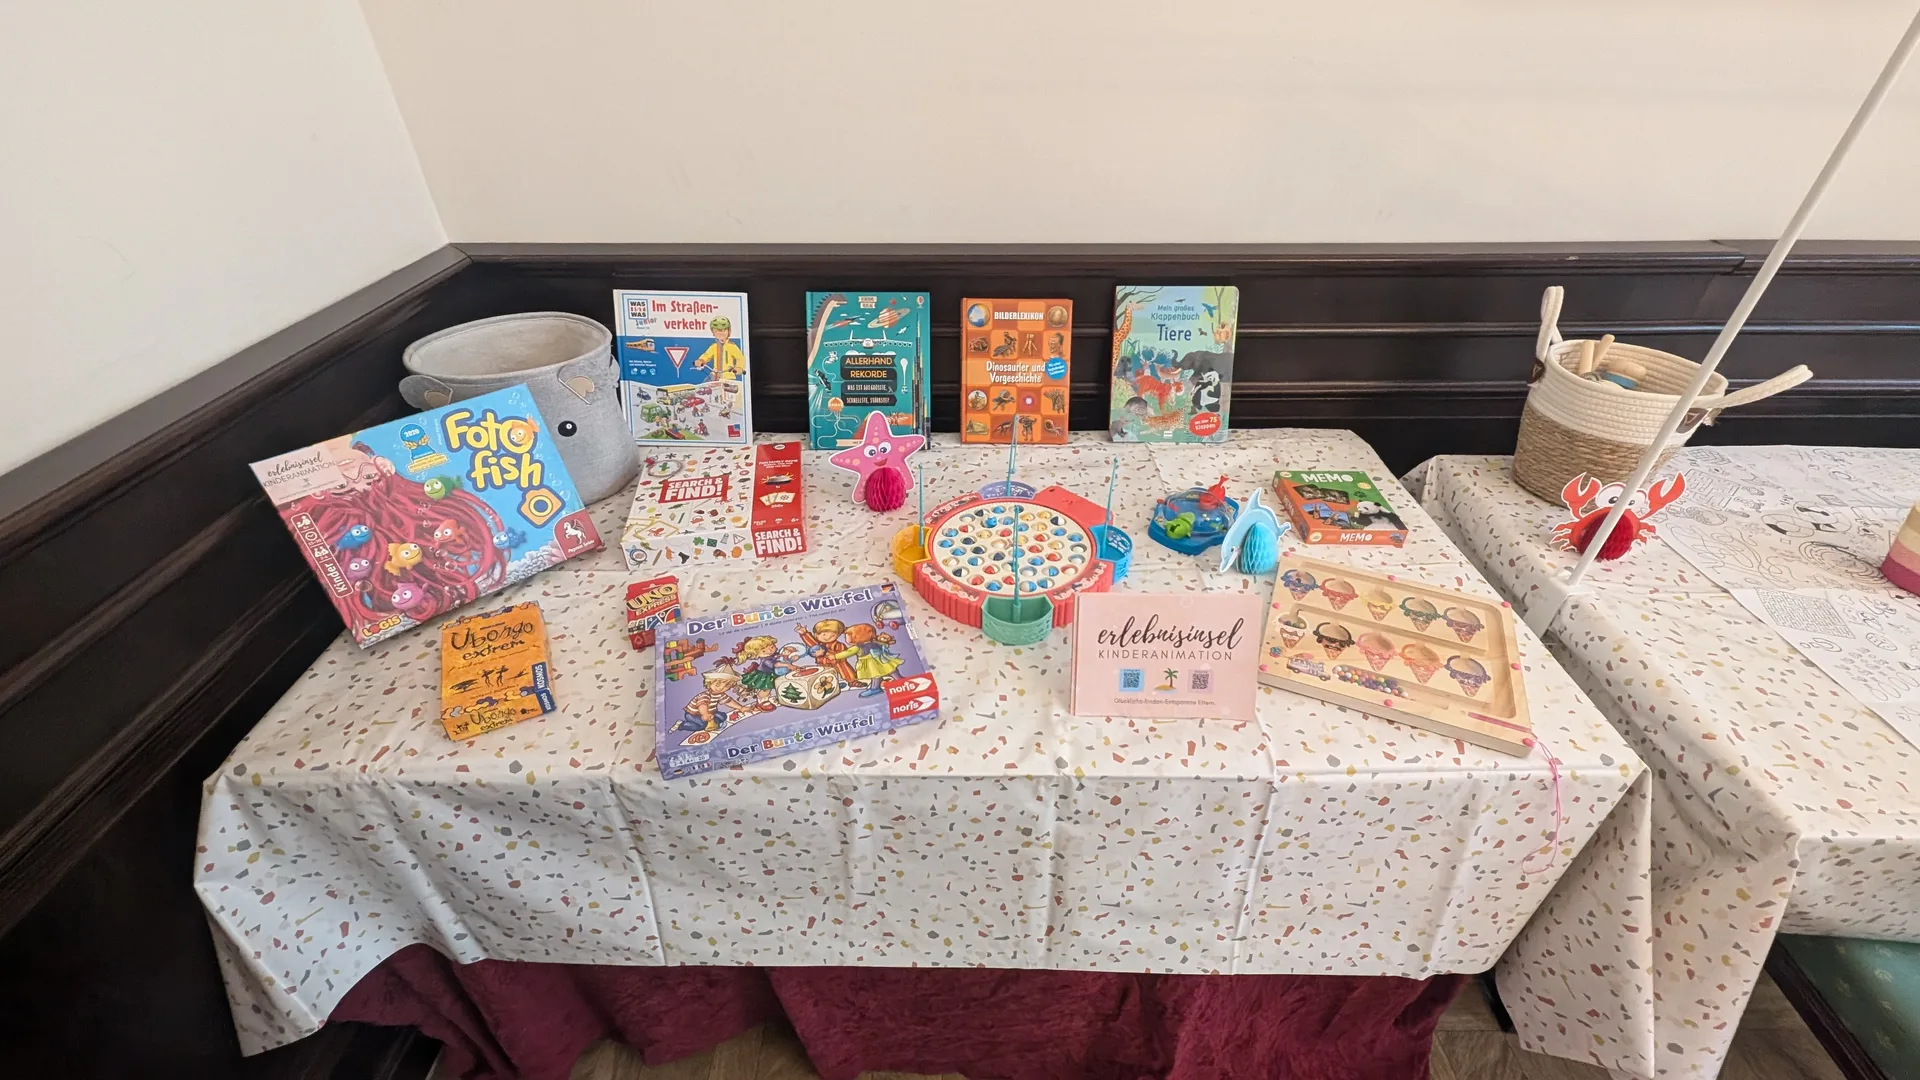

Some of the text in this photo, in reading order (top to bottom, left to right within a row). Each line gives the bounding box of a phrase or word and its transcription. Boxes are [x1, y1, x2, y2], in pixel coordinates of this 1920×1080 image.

[652, 300, 718, 315] Im Straßen-
[1157, 304, 1195, 313] Mein großes
[994, 311, 1044, 320] BILDERLEXIKON
[1150, 312, 1200, 322] Klappenbuch
[664, 319, 707, 330] verkehr
[1156, 323, 1192, 341] Tiere
[845, 357, 893, 366] ALLERHAND
[986, 360, 1030, 372] Dinosaurier
[1031, 362, 1046, 372] und
[850, 370, 887, 378] REKORDE
[989, 373, 1042, 385] Vorgeschichte
[403, 428, 420, 438] 2020
[1194, 423, 1216, 431] Klappen
[262, 460, 337, 487] KINDERANIMATION
[471, 450, 542, 489] fish
[668, 477, 723, 489] SEARCH &
[665, 483, 723, 501] FIND!
[755, 527, 801, 541] SEARCH &
[1340, 533, 1373, 542] MEMO
[756, 537, 803, 555] FIND!
[324, 562, 348, 593] Kinder
[626, 583, 678, 611] UNO
[635, 594, 677, 616] EXPRESS
[687, 589, 874, 636] Der Bunte Würfel
[451, 621, 534, 650] Ubongo
[1097, 613, 1245, 650] erlebnisinsel
[462, 640, 526, 661] extrem
[1098, 649, 1233, 661] KINDERANIMATION
[534, 664, 545, 689] KOSMOS
[889, 681, 916, 695] noris
[540, 692, 552, 710] KOSMOS
[893, 700, 919, 714] noris
[470, 708, 517, 725] Ubongo
[480, 718, 513, 731] extrem
[727, 715, 874, 759] Der Bunte Würfel
